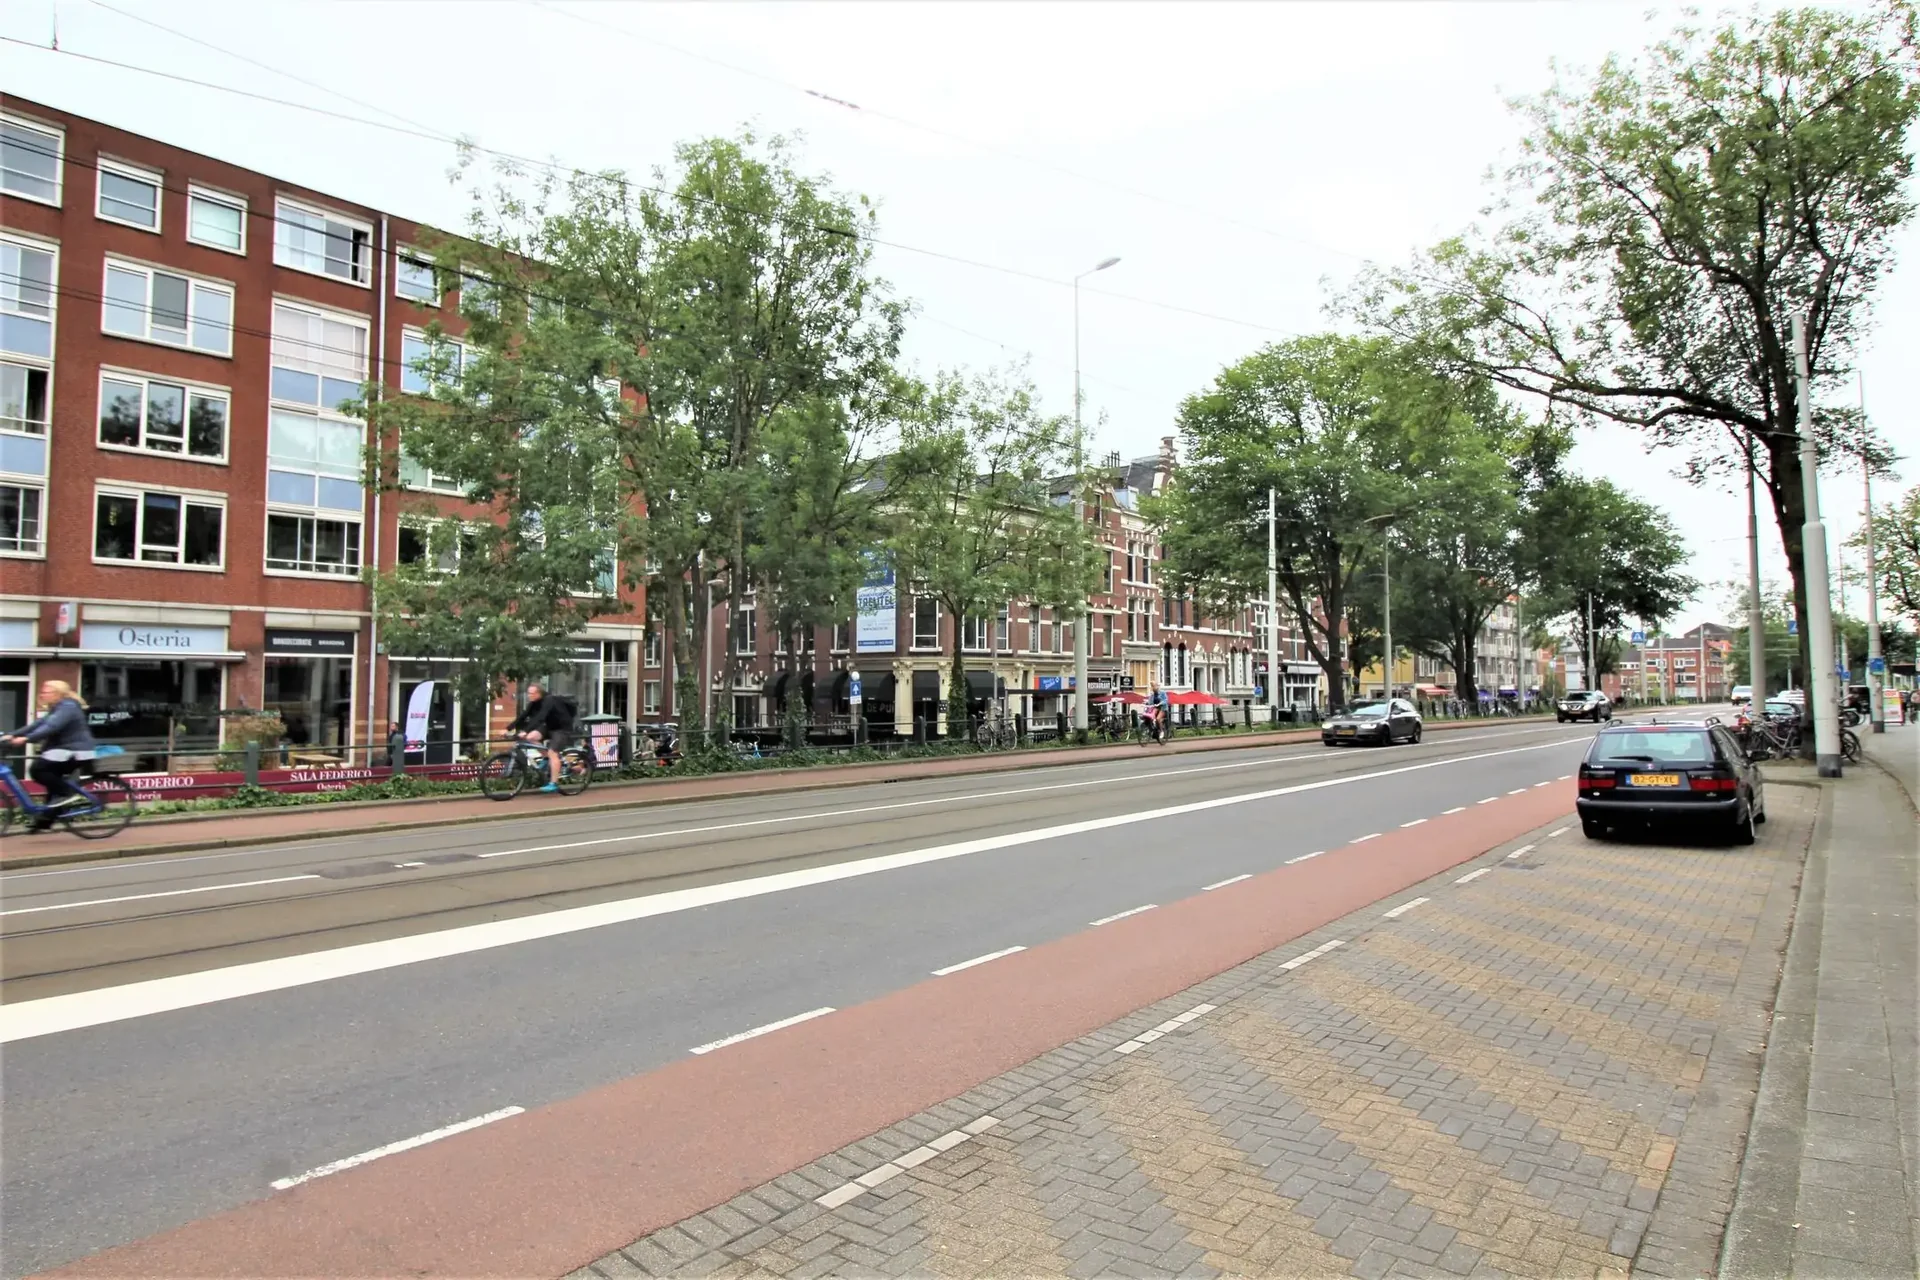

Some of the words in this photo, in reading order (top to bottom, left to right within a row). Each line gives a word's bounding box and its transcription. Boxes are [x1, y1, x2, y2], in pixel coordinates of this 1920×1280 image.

[118, 627, 190, 647] Osteria
[290, 771, 317, 781] SALA
[319, 769, 372, 780] FEDERICO
[129, 776, 194, 788] FEDERICO
[316, 782, 346, 790] Osteria
